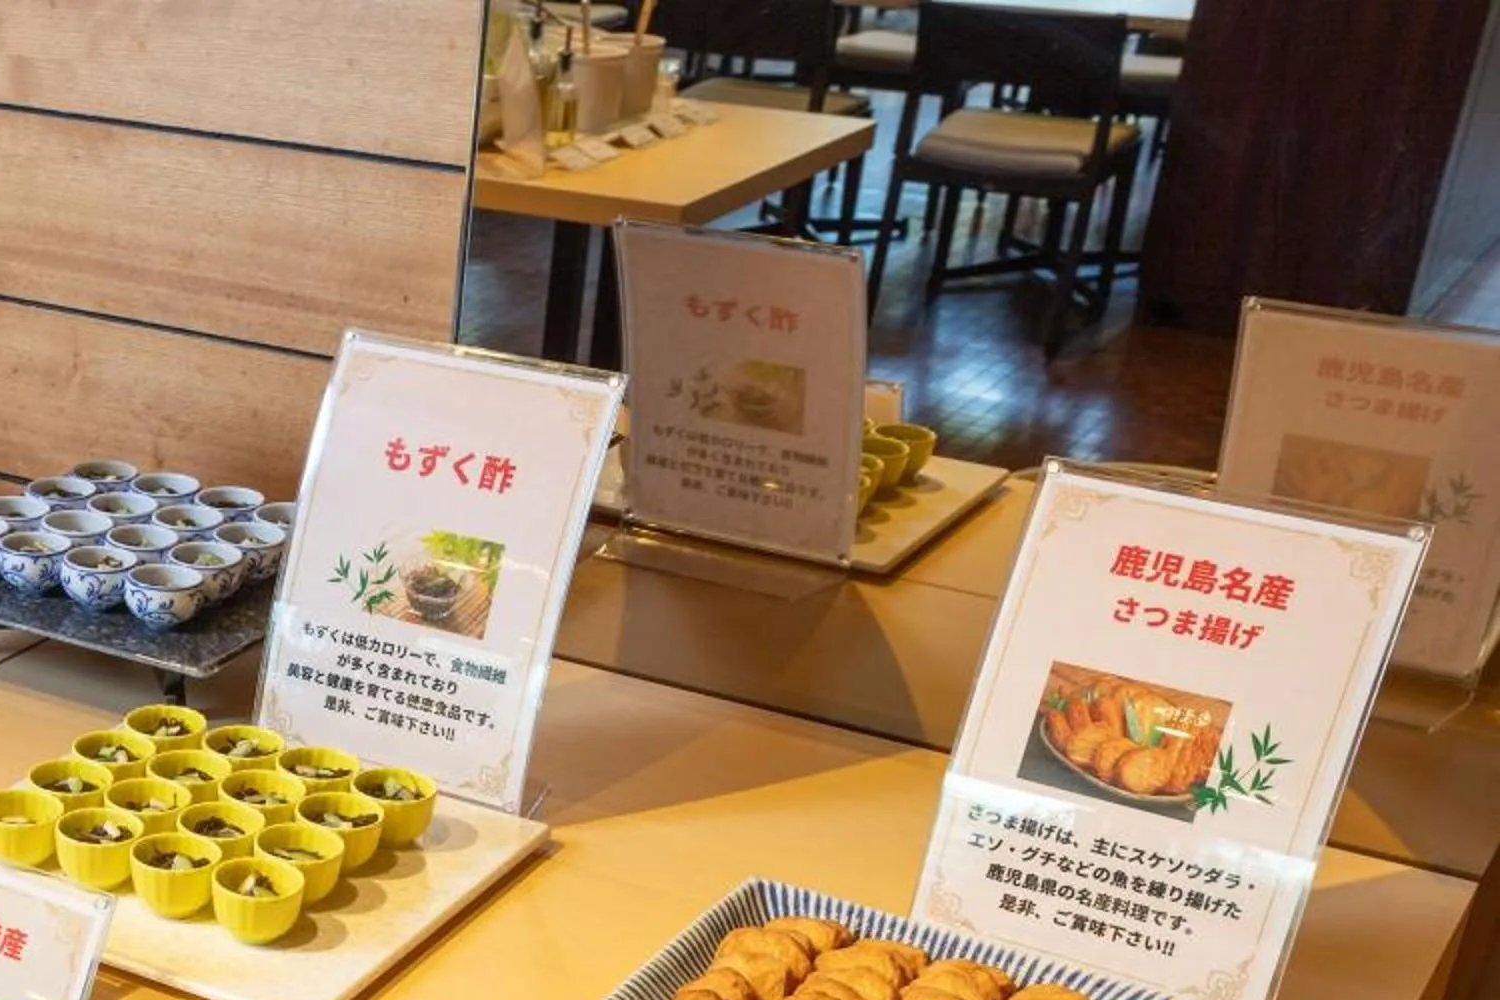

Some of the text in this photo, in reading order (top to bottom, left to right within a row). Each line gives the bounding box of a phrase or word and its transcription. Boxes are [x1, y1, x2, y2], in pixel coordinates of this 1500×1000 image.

[686, 295, 800, 334] もずく酢
[1316, 355, 1467, 399] 鹿児島名産
[1325, 391, 1449, 425] さつま揚げ
[385, 437, 517, 494] もずく酢
[1109, 545, 1296, 611] 鹿児島名産
[1113, 597, 1265, 650] さつま揚げ
[336, 654, 459, 695] が多く含まれており
[966, 803, 1257, 891] さつま揚げは、主にスケソウダラ・
[967, 832, 1243, 921] エソ・グチなどの魚を練り揚げた
[985, 863, 1194, 936] 鹿児島県の名産料理です。
